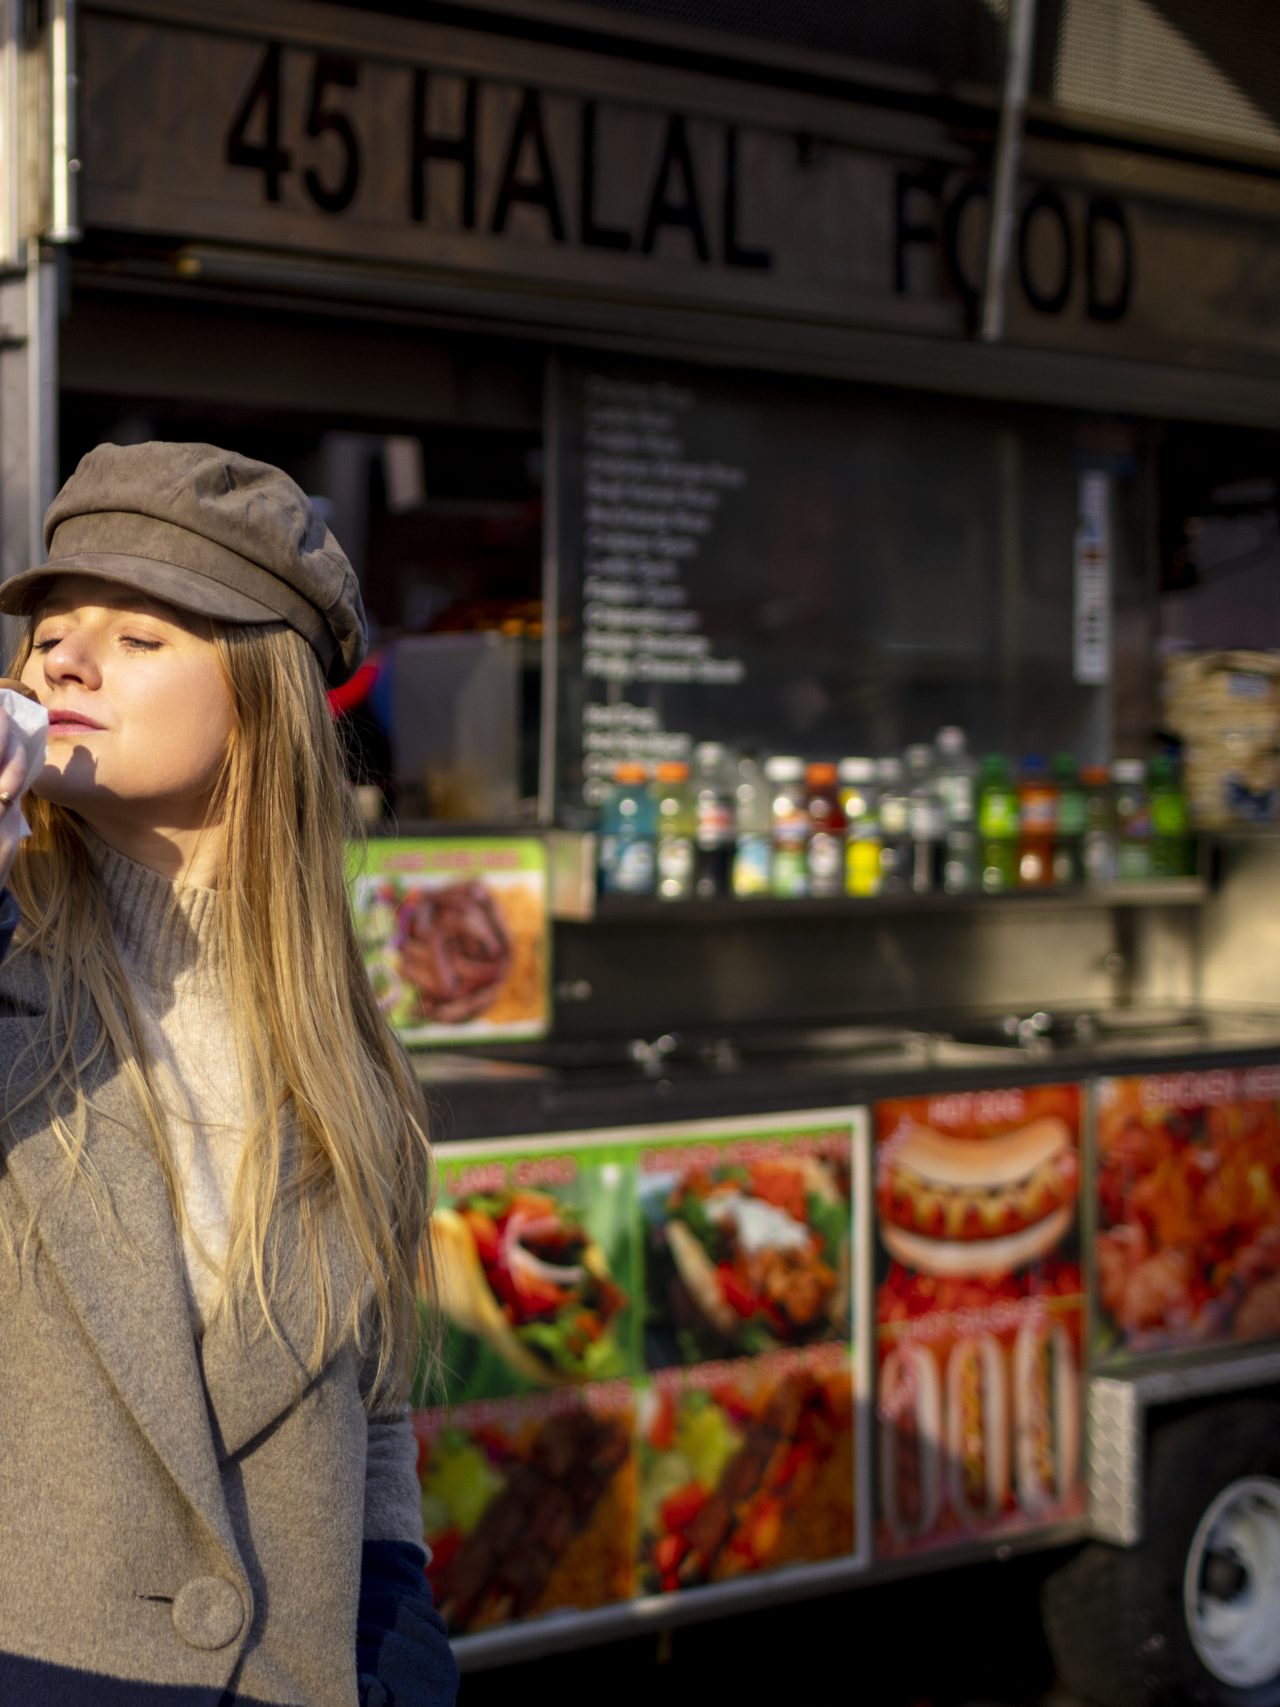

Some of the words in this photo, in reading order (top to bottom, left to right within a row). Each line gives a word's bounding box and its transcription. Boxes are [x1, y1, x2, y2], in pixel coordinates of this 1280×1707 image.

[227, 40, 360, 212] 45
[408, 67, 771, 268] HALAL
[895, 172, 1132, 321] FOOD
